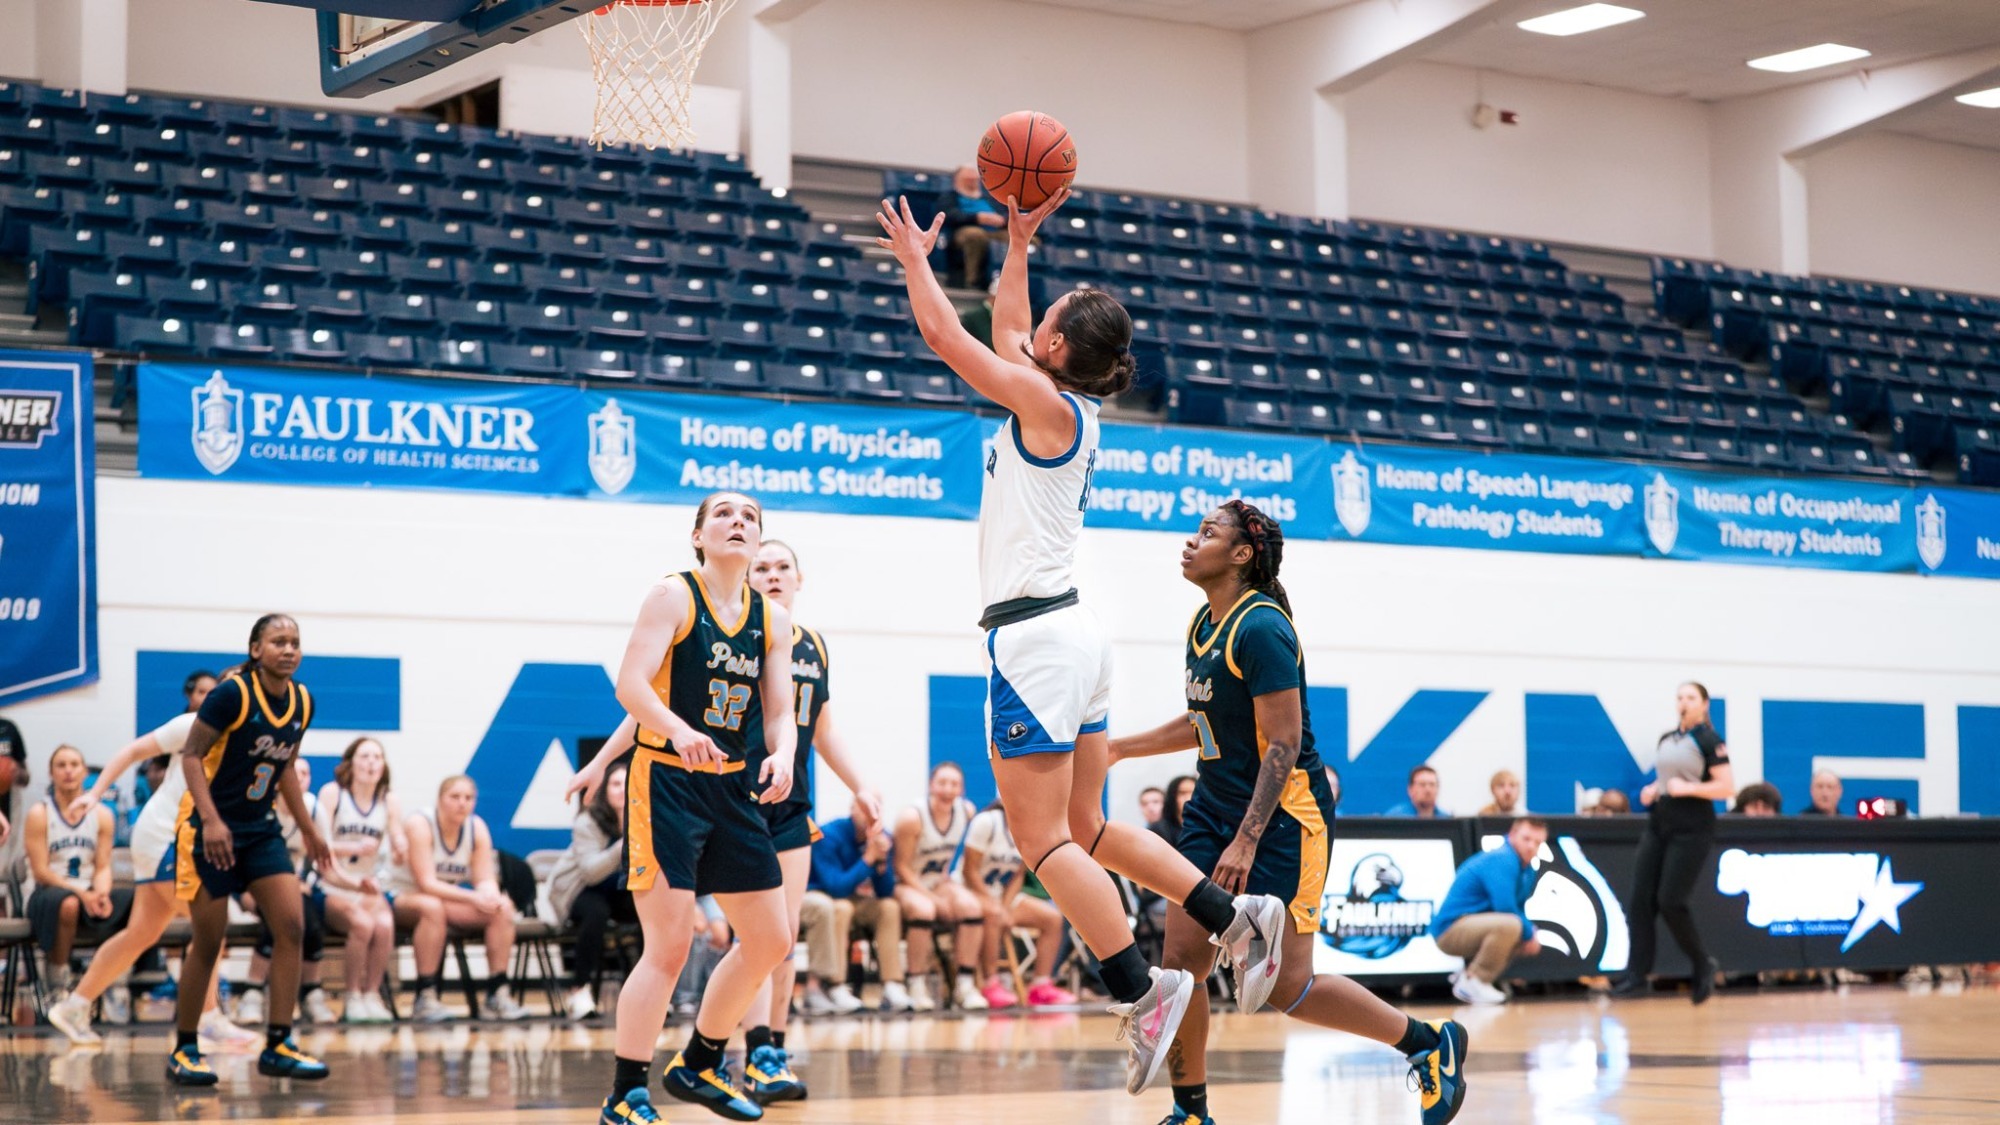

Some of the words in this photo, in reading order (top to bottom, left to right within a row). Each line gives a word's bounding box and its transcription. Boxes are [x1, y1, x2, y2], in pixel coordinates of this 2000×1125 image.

[250, 393, 539, 451] FAULKNER
[681, 417, 764, 450] Home
[772, 422, 806, 452] of
[812, 425, 942, 462] Physician
[250, 442, 337, 462] COLLEGE
[343, 448, 366, 464] OF
[373, 449, 446, 469] HEALTH
[452, 454, 539, 473] SCIENCES
[1151, 445, 1183, 476] of
[1187, 448, 1293, 486] Physical
[680, 459, 813, 494] Assistant
[819, 467, 944, 500] Students
[1376, 463, 1437, 491] Home
[1440, 467, 1464, 492] of
[1466, 470, 1538, 500] Speech
[1540, 475, 1633, 510] Language
[1086, 485, 1175, 521] herapy
[1413, 502, 1514, 538] Pathology
[1517, 509, 1603, 538] Students
[1693, 486, 1751, 514] Home
[1754, 490, 1778, 516] of
[1779, 492, 1900, 525] Occupational
[1718, 521, 1797, 557] Therapy
[1800, 528, 1882, 556] Students
[706, 641, 760, 678] Point
[790, 658, 820, 679] oint
[704, 678, 752, 731] 32
[246, 762, 275, 801] 3
[1323, 894, 1434, 933] FAULKNER
